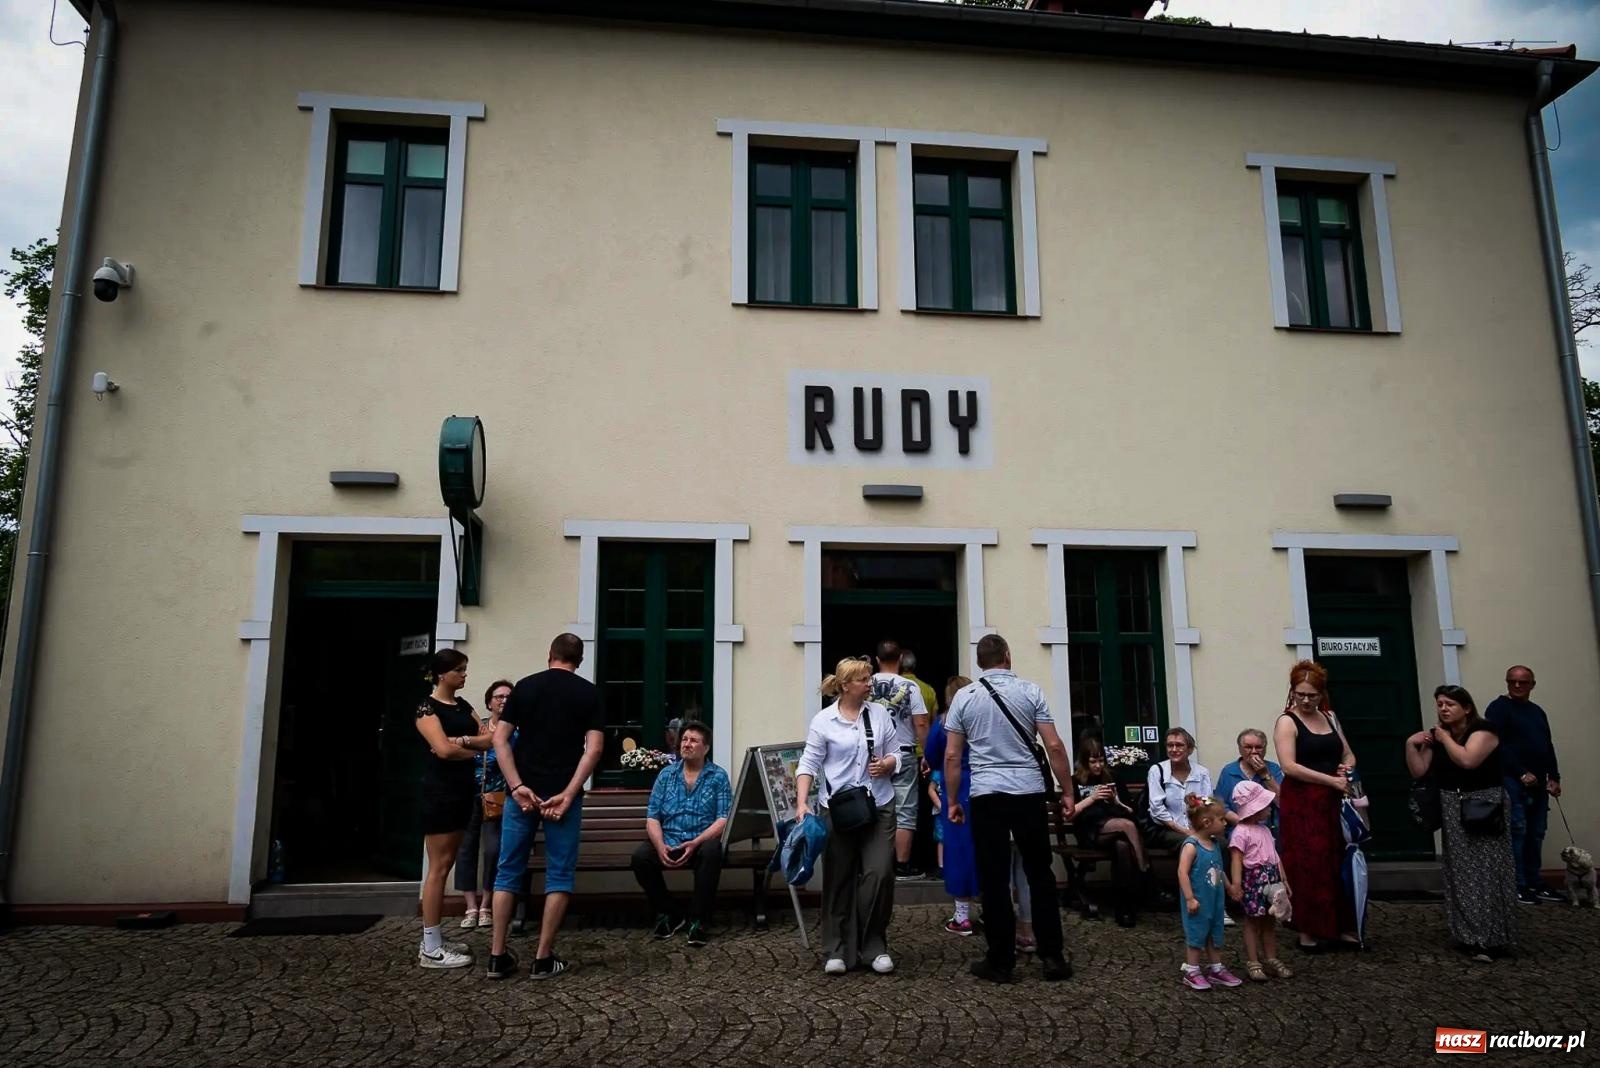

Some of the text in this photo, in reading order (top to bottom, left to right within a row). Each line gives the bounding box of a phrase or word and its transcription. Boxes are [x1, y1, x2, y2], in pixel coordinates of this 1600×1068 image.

[805, 385, 978, 455] RUDY
[1321, 642, 1378, 651] BIURO STACYJNE
